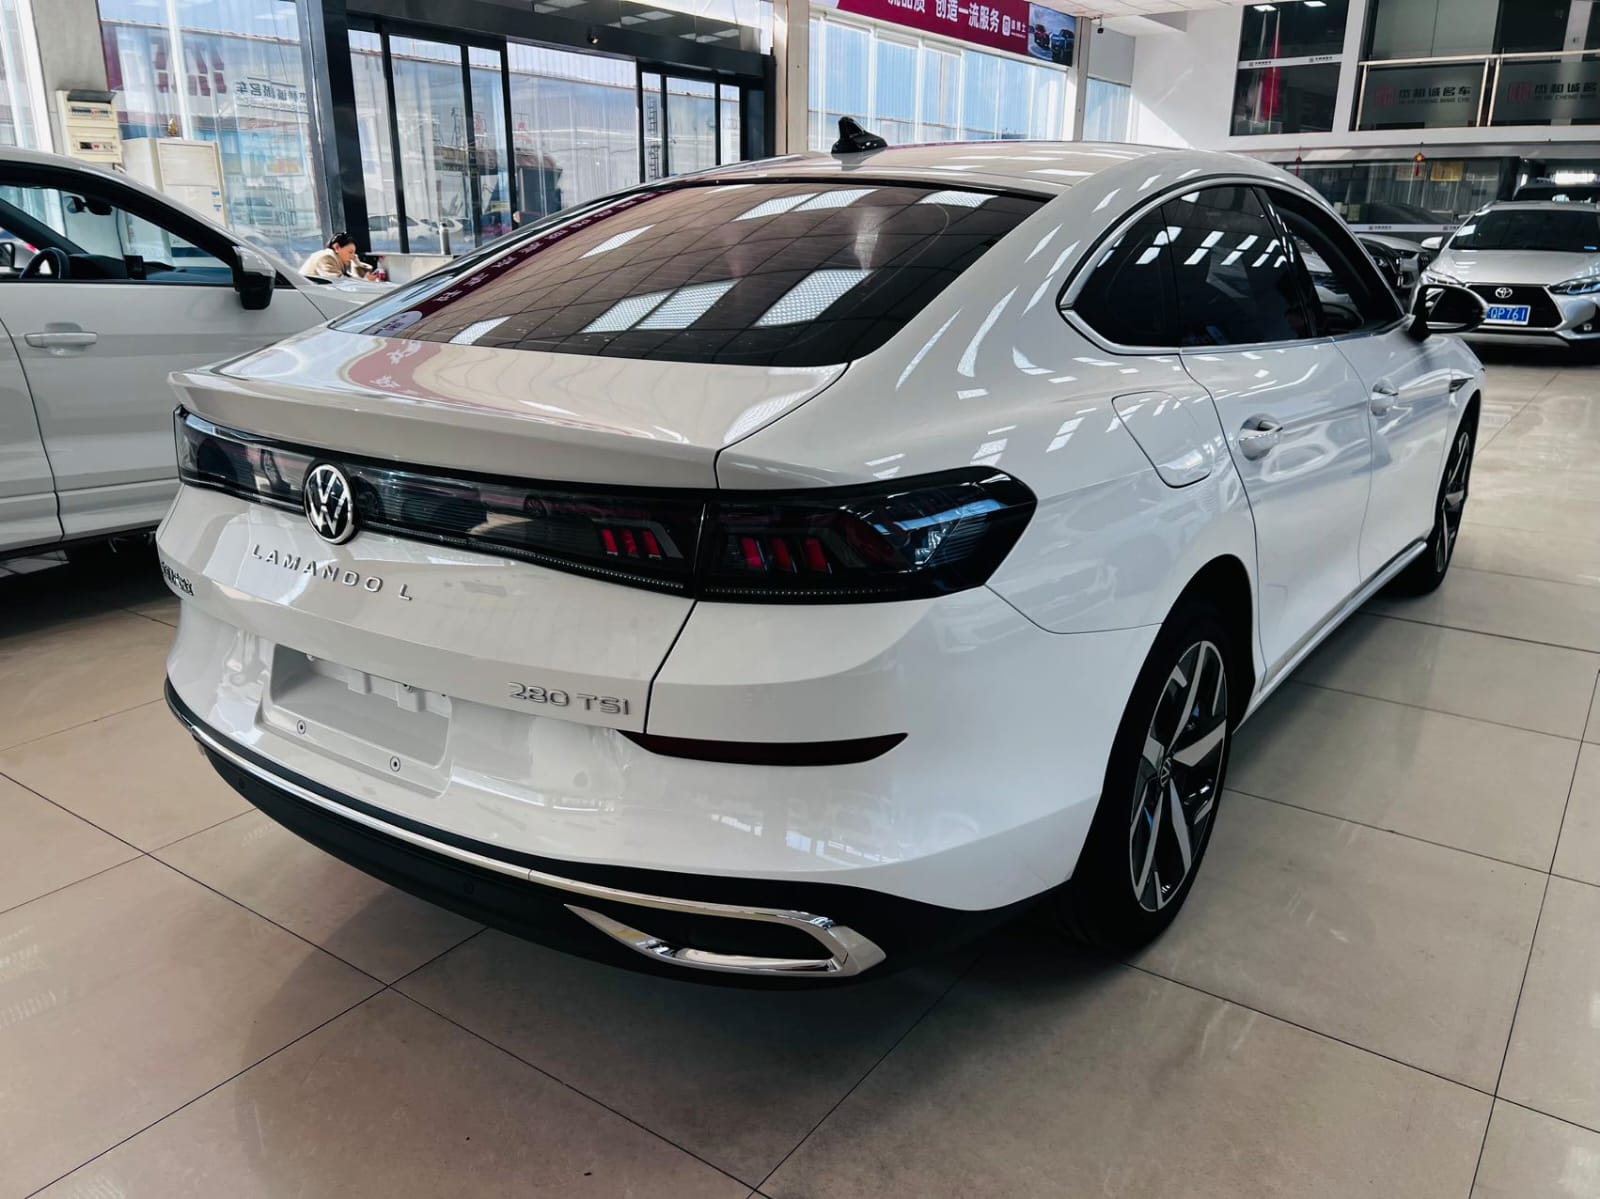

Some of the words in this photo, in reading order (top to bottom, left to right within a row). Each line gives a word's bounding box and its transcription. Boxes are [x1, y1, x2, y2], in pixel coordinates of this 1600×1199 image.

[935, 0, 1000, 33] 创造一流服务
[252, 544, 383, 593] LAMANDO
[399, 584, 413, 601] L
[507, 681, 570, 707] 280
[576, 692, 629, 715] TSI
